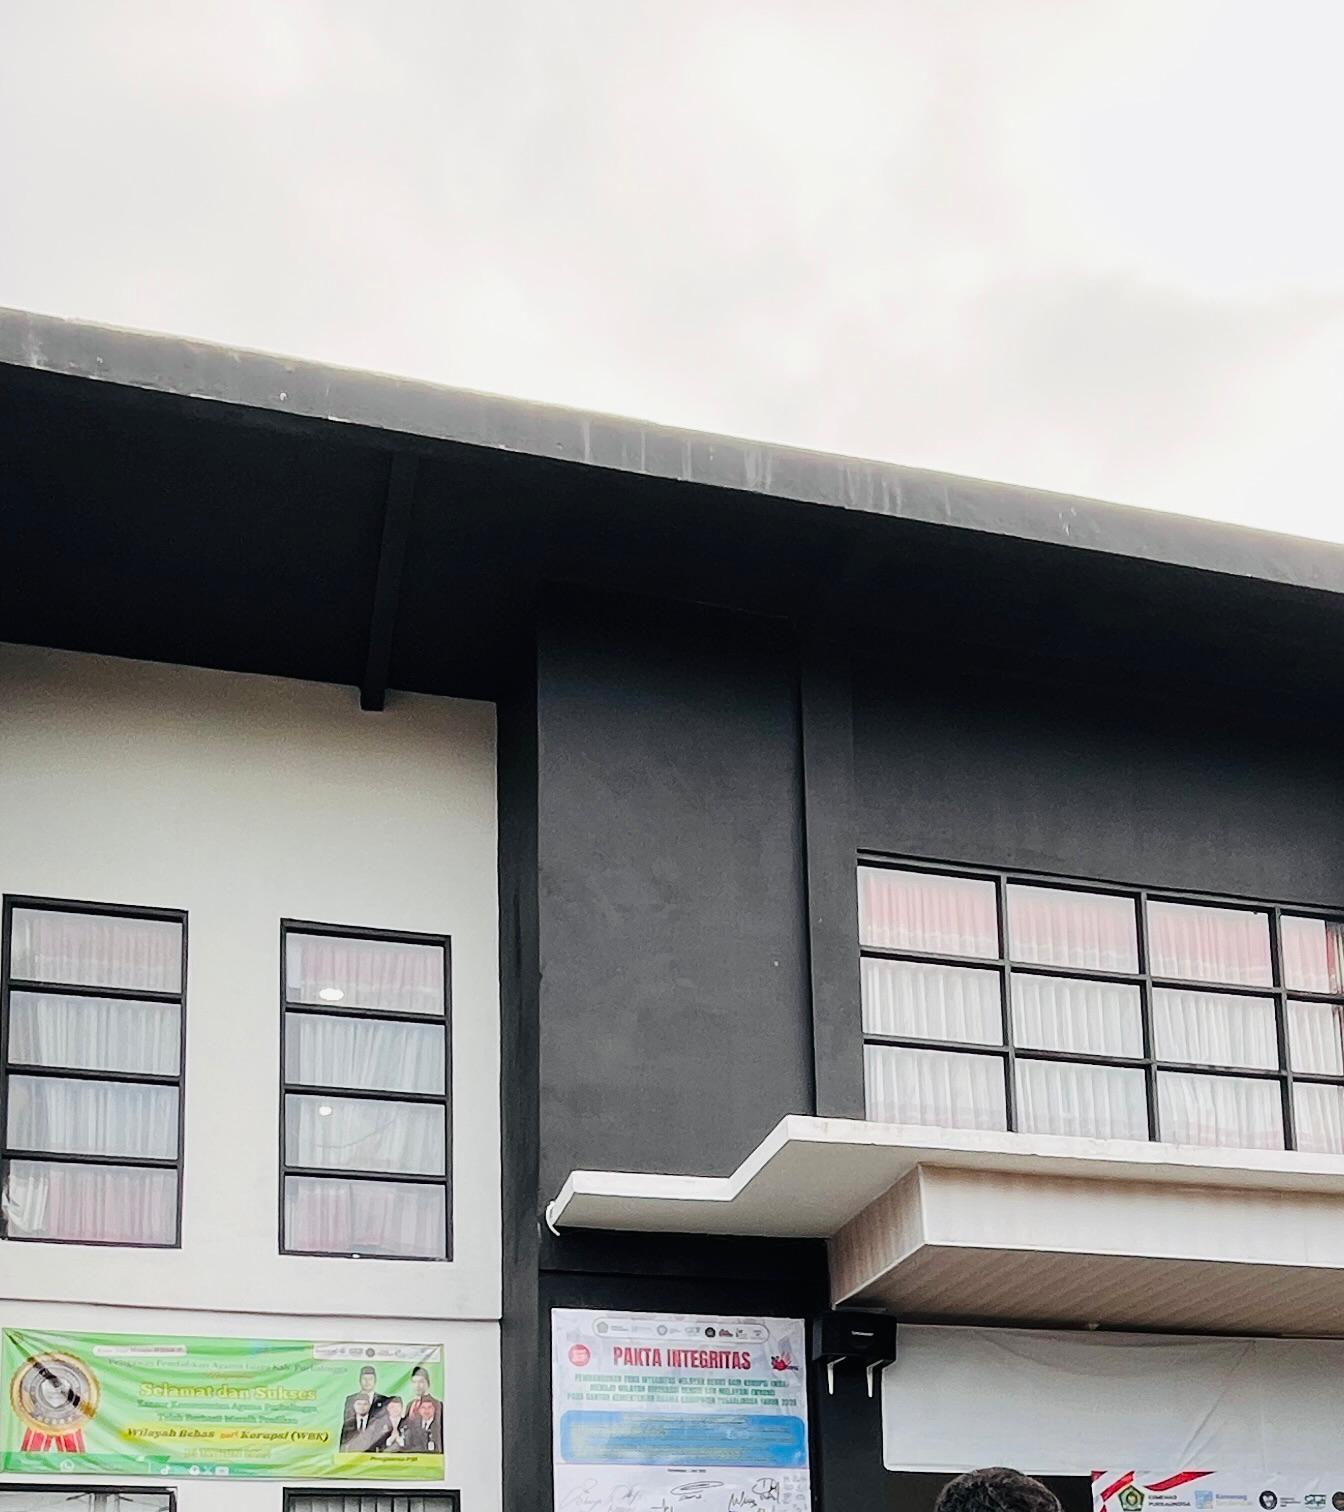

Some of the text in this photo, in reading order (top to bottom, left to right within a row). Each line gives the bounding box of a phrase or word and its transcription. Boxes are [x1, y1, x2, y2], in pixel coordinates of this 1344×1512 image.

[613, 1346, 752, 1370] PAKTA INTEGRITAS
[140, 1382, 316, 1400] Selamat dan Sukses
[127, 1427, 177, 1438] Wilayah
[179, 1429, 215, 1438] Bebas
[240, 1430, 289, 1441] Korupsi
[290, 1430, 329, 1443] (WBK)
